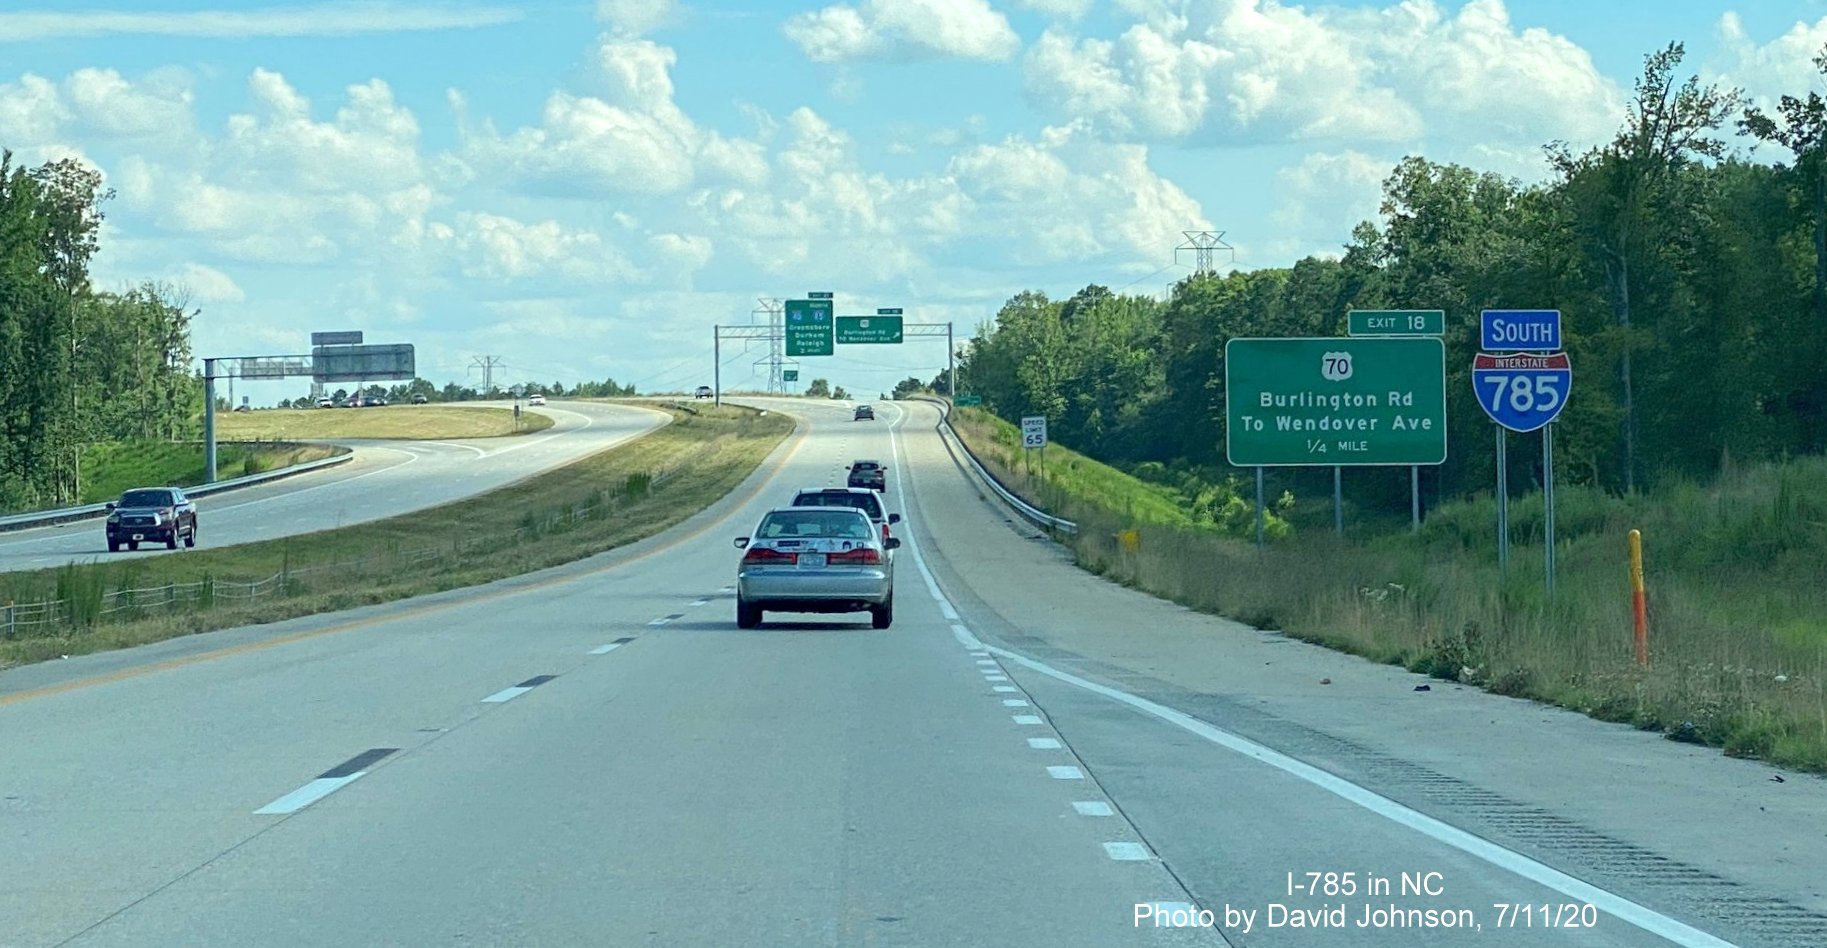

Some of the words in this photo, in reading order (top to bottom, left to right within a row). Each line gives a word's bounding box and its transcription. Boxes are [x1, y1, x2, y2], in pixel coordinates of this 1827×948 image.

[1367, 317, 1397, 329] EXIT
[1407, 316, 1426, 331] 18
[1492, 318, 1553, 343] SOUTH
[1325, 358, 1349, 375] 70
[1495, 357, 1549, 369] INTERSTATE
[1260, 391, 1378, 412] Burlington
[1388, 391, 1414, 407] Rd
[1483, 375, 1560, 413] 785
[1241, 416, 1264, 431] To
[1276, 415, 1379, 431] Wendover
[1391, 415, 1433, 431] Ave
[1026, 434, 1043, 444] 65
[1306, 439, 1328, 454] 1/4
[1338, 440, 1369, 452] MILE
